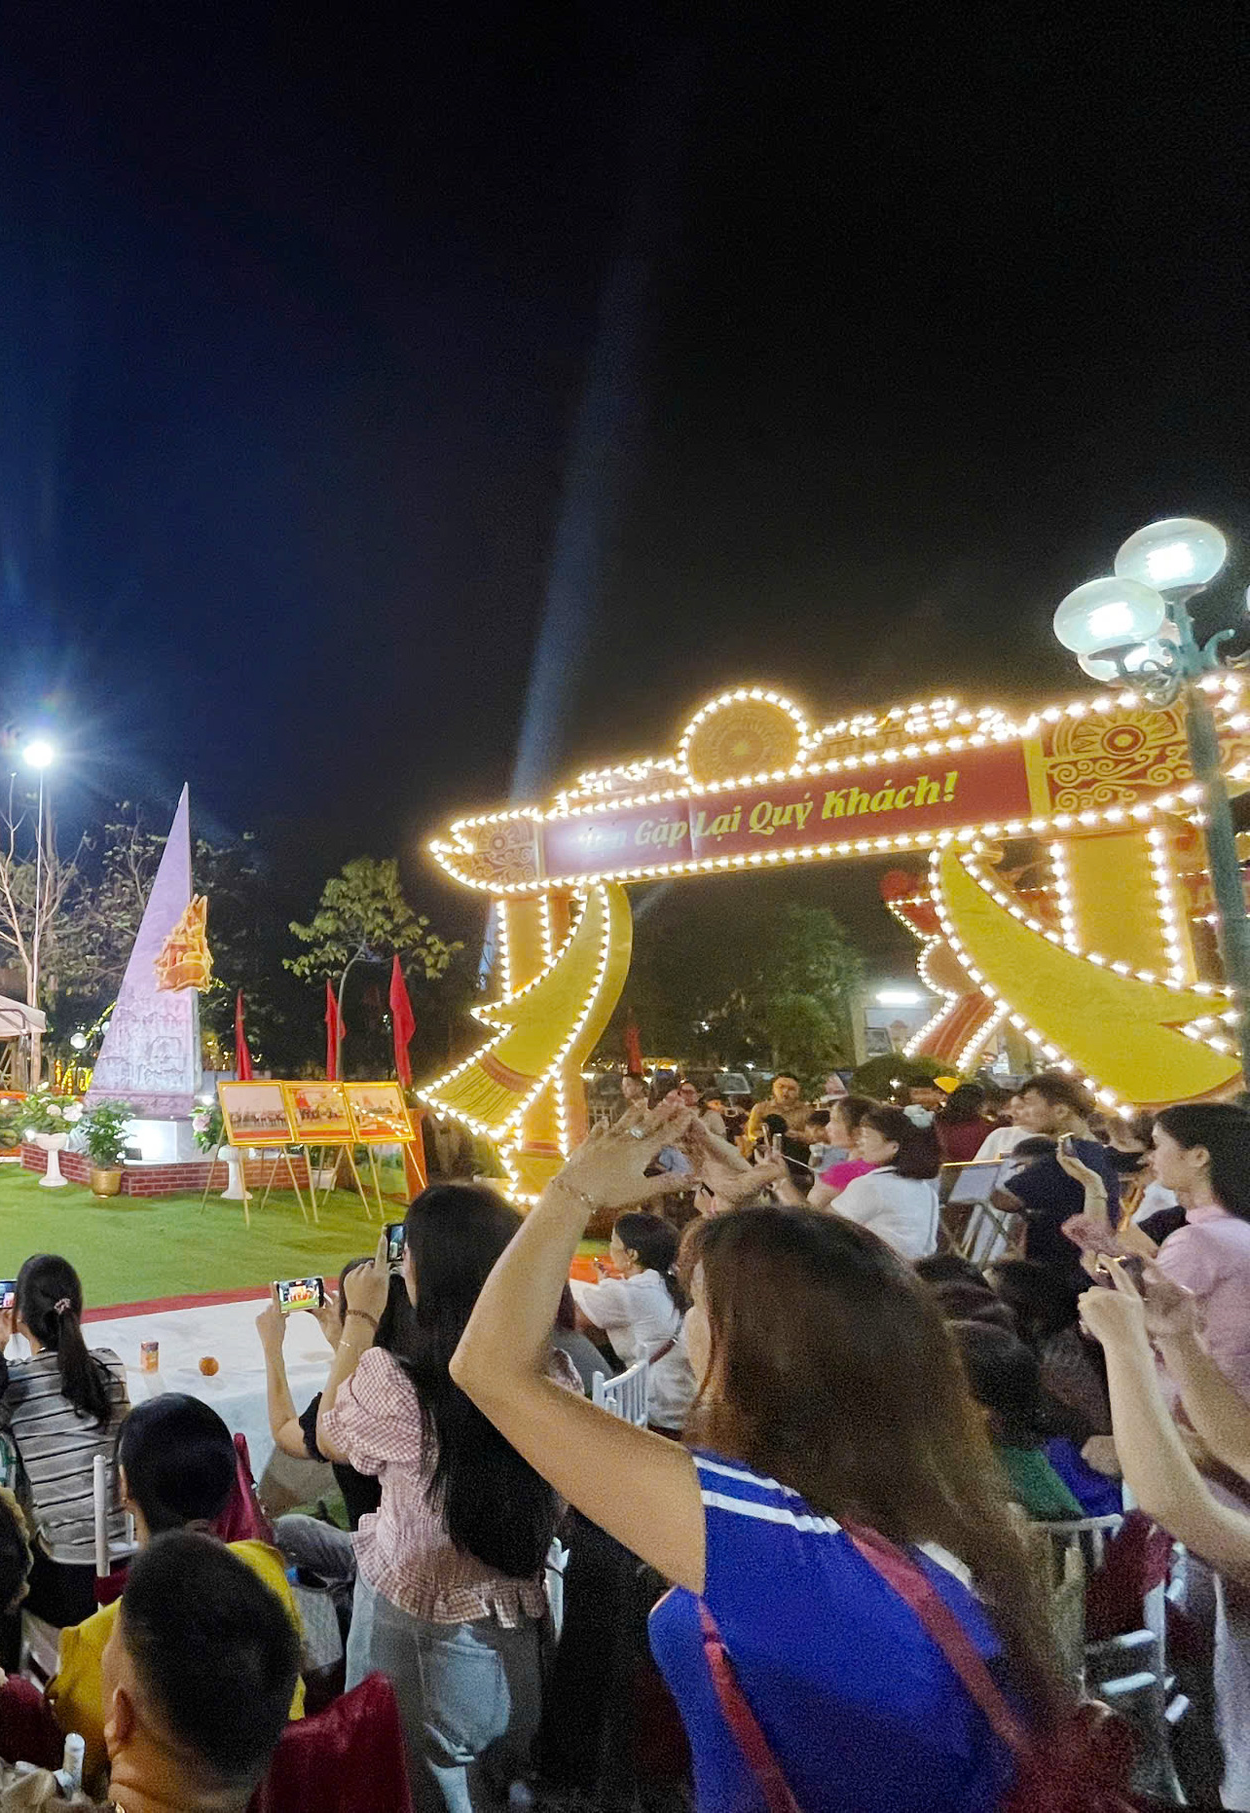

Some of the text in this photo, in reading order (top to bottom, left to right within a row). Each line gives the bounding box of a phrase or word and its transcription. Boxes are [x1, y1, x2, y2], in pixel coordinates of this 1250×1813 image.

[634, 817, 688, 850] Gặp
[693, 805, 742, 842] Lại
[748, 792, 813, 836] Quý
[821, 770, 959, 821] Khách!
